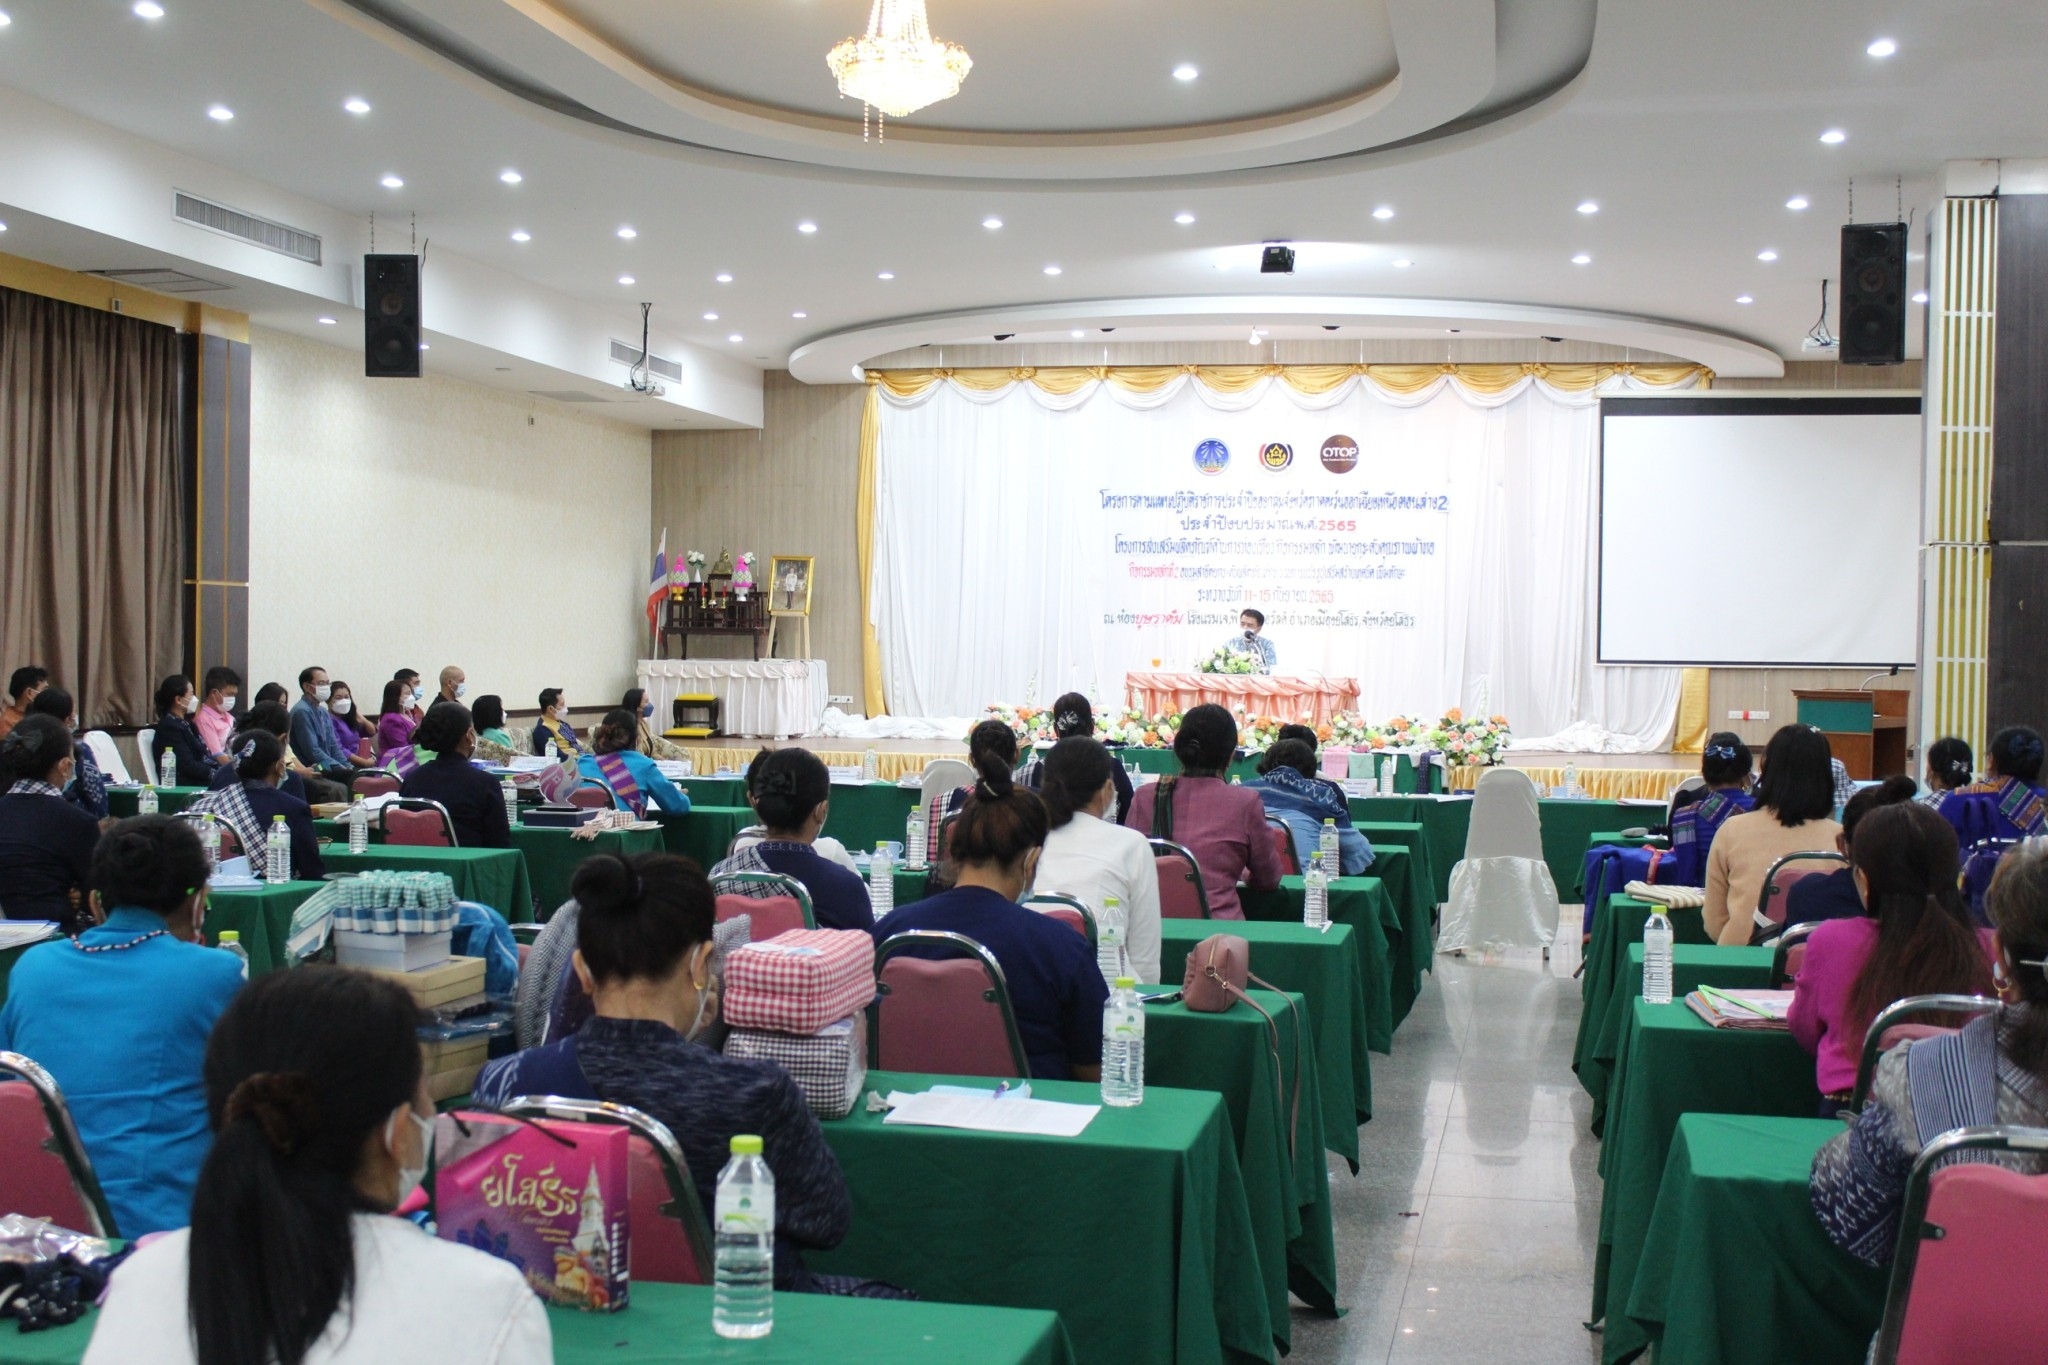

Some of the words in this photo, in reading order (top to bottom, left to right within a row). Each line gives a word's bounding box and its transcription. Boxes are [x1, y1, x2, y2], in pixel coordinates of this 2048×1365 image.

[1323, 447, 1357, 458] OTOP
[1309, 589, 1334, 603] 2565
[481, 1153, 580, 1217] ยโสธร
